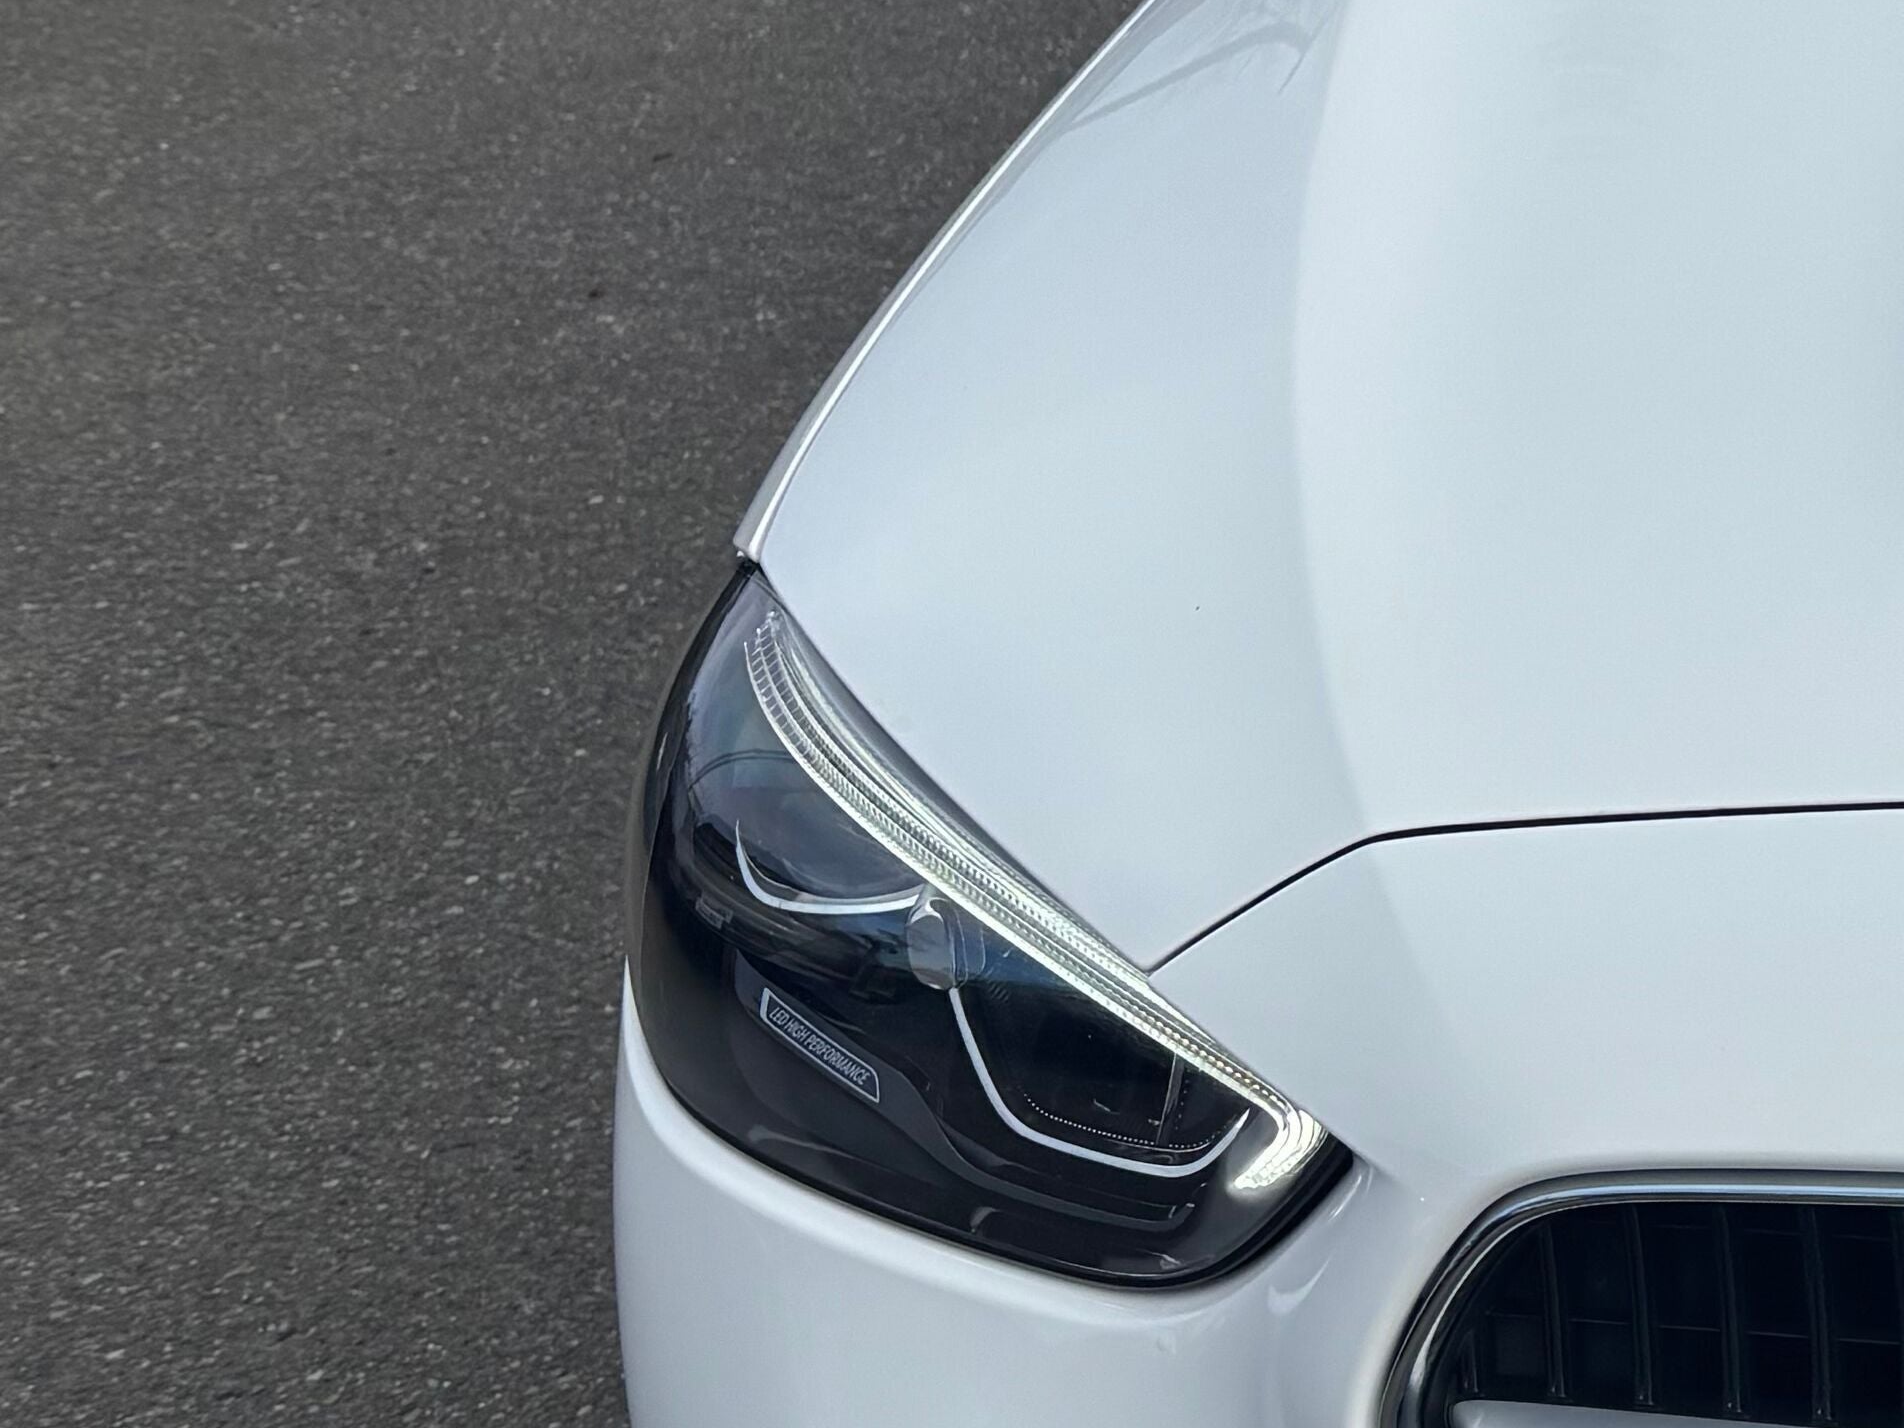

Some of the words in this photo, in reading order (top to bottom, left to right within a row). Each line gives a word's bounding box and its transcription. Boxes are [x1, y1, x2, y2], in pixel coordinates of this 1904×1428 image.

[768, 1007, 790, 1026] LED
[784, 1018, 812, 1043] HIGH
[803, 1033, 871, 1085] PERFORMANCE
